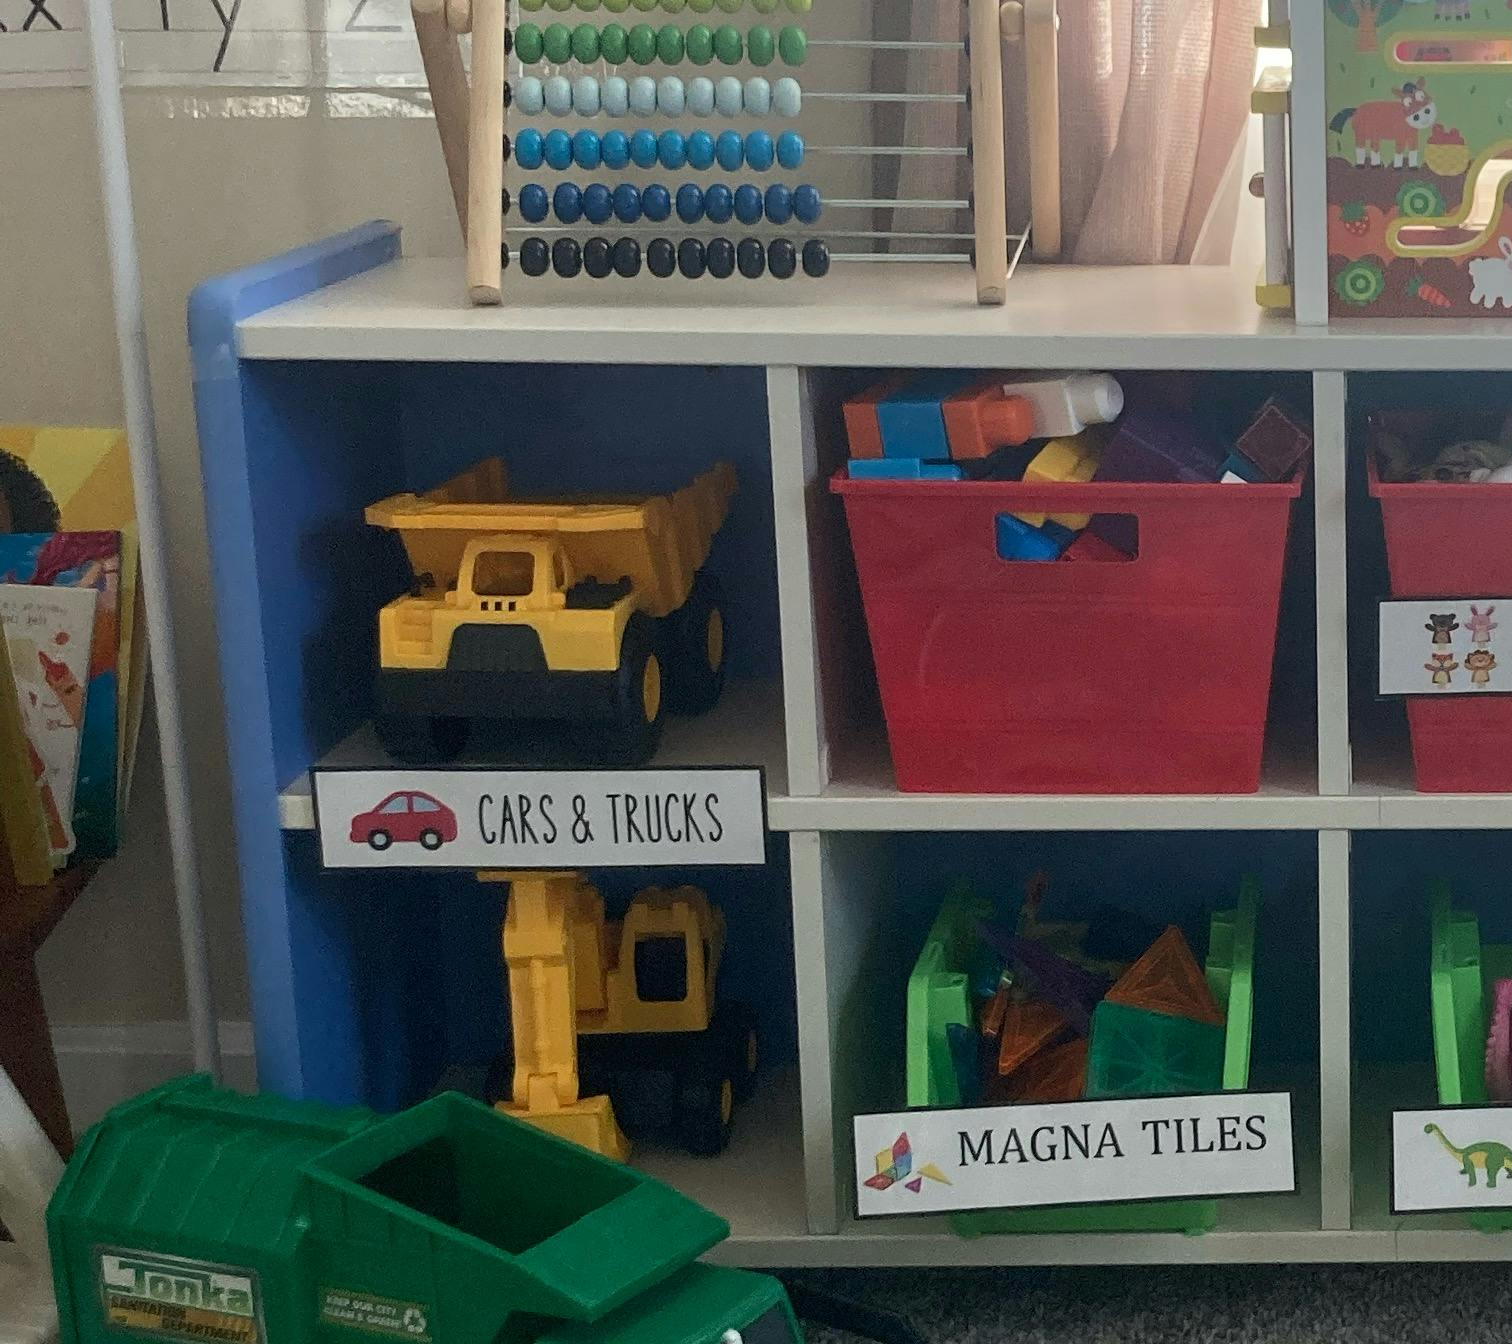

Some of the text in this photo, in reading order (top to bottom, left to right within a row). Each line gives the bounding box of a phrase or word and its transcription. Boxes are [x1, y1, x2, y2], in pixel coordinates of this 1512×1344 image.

[478, 792, 724, 844] CARS & TRUCKS
[957, 1114, 1268, 1167] MAGNA TILES
